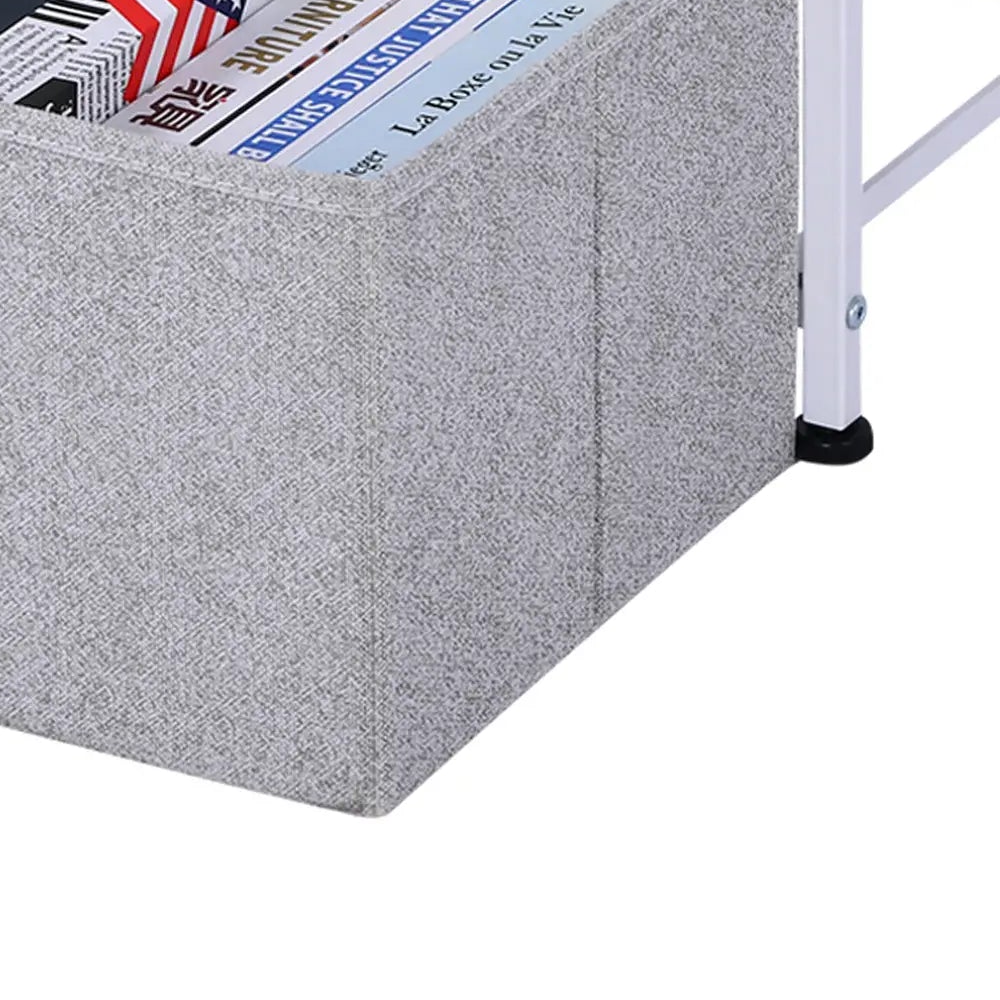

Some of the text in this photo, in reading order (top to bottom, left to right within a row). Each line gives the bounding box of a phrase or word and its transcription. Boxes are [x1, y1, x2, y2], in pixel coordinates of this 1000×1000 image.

[318, 34, 422, 100] JUSTICE
[388, 3, 585, 137] La Boxe ou la Vie
[251, 100, 336, 144] SHALL
